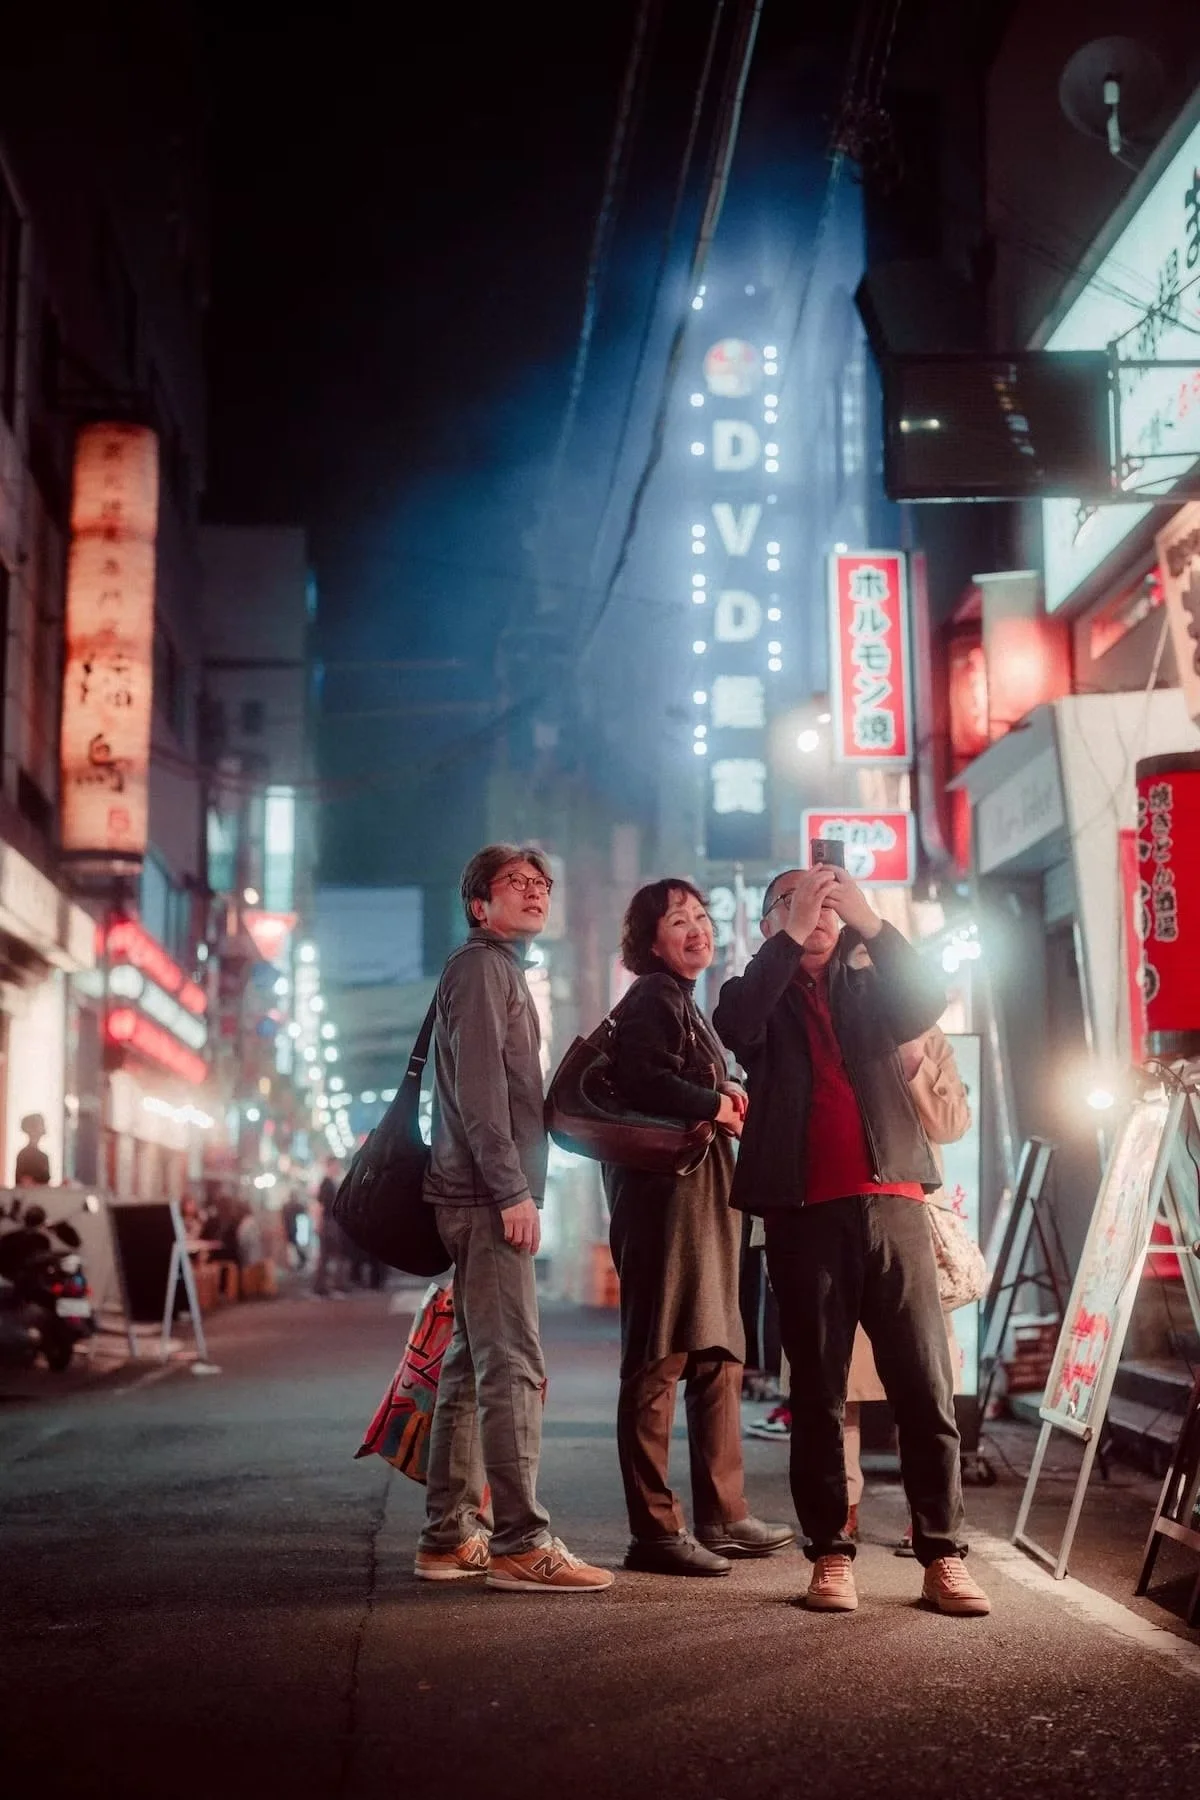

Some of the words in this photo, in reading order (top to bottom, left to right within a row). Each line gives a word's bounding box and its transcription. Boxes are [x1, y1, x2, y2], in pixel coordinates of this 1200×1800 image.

[850, 566, 894, 747] ホルモン焼
[531, 1555, 565, 1579] N
